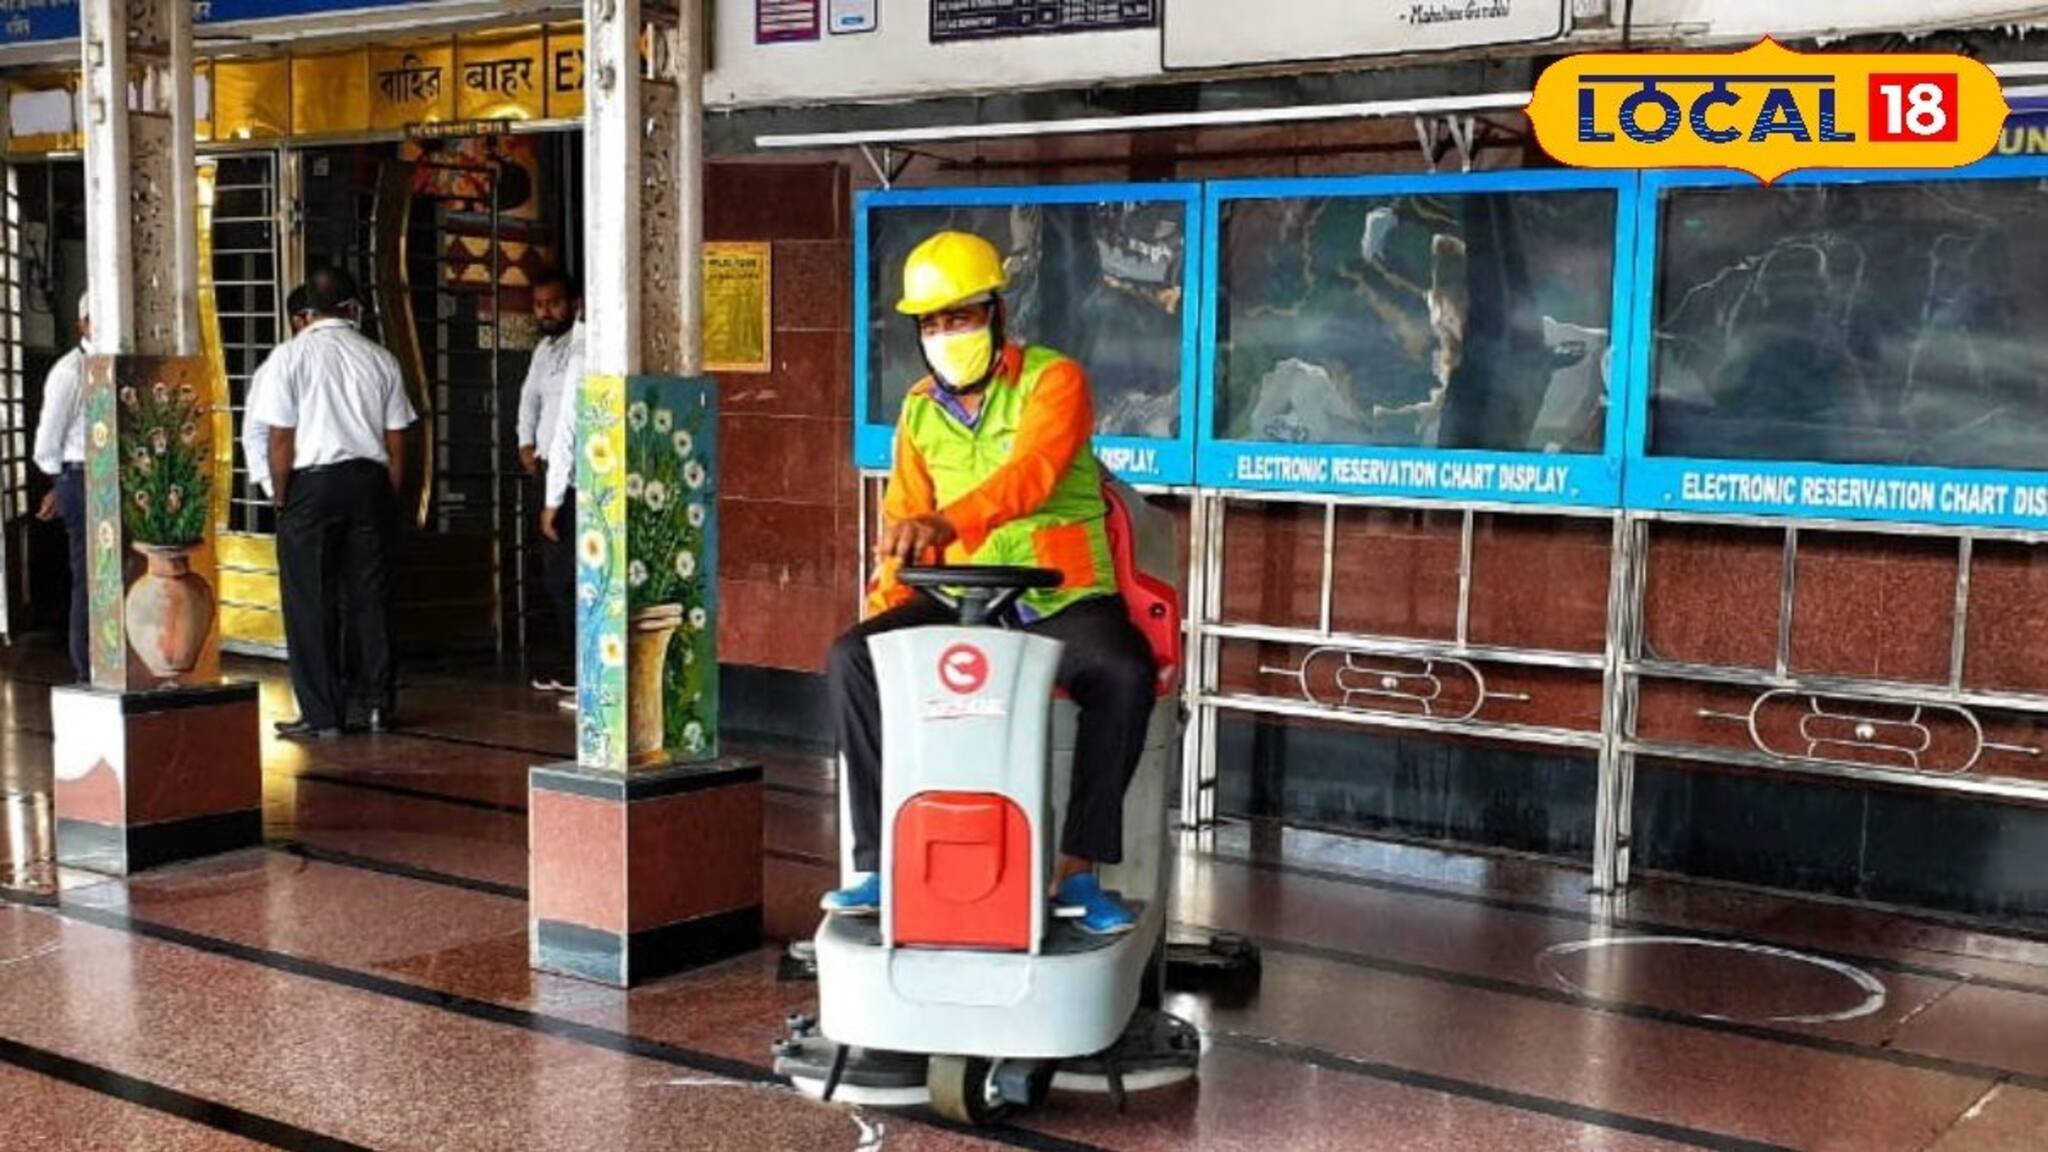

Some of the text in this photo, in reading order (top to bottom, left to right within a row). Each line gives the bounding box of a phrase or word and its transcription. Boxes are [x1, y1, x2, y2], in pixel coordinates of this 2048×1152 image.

[464, 58, 533, 97] बाहर
[1237, 455, 1328, 481] ELECTRONIC
[1331, 457, 1437, 488] RESERVATION
[1440, 462, 1496, 491] CHART
[1682, 472, 1796, 505] ELECTRONIC
[1801, 476, 1936, 512] RESERVATION
[1939, 481, 2010, 515] CHART
